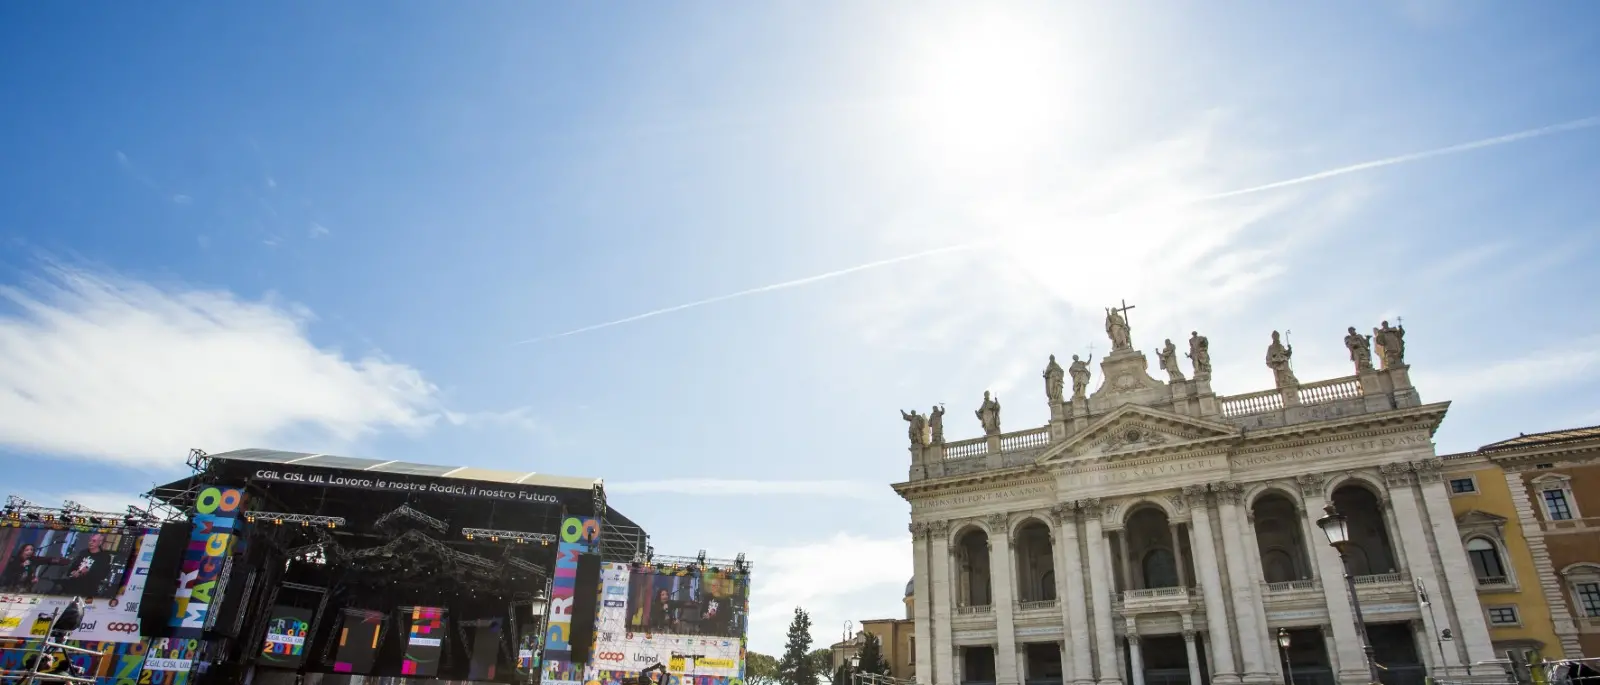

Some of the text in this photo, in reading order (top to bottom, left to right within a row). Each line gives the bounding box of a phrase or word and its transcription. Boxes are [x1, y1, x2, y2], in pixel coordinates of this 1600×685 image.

[256, 469, 559, 503] CGIL CISL UIL Lavoro: le nostre Radici, il nostro Futuro.
[107, 622, 139, 634] coop
[599, 652, 624, 662] coop
[633, 653, 659, 665] Unipol
